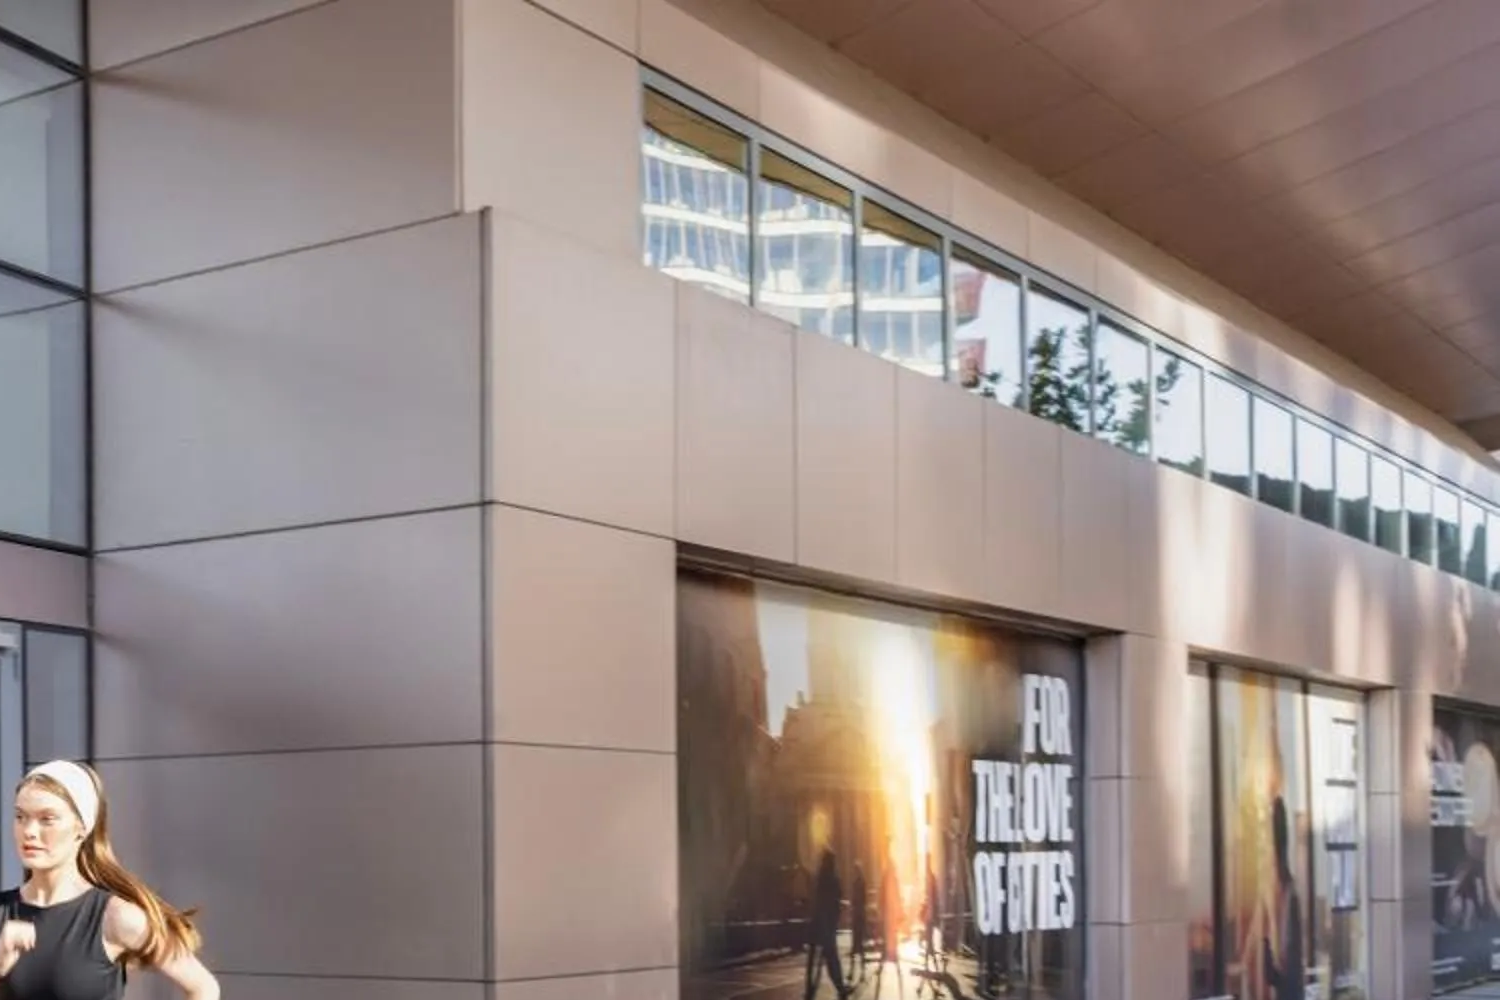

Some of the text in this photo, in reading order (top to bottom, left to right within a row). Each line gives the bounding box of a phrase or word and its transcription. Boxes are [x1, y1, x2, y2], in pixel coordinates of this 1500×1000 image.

[1022, 673, 1072, 755] FOR
[972, 759, 1074, 842] THE LOVE
[973, 851, 1006, 935] OF
